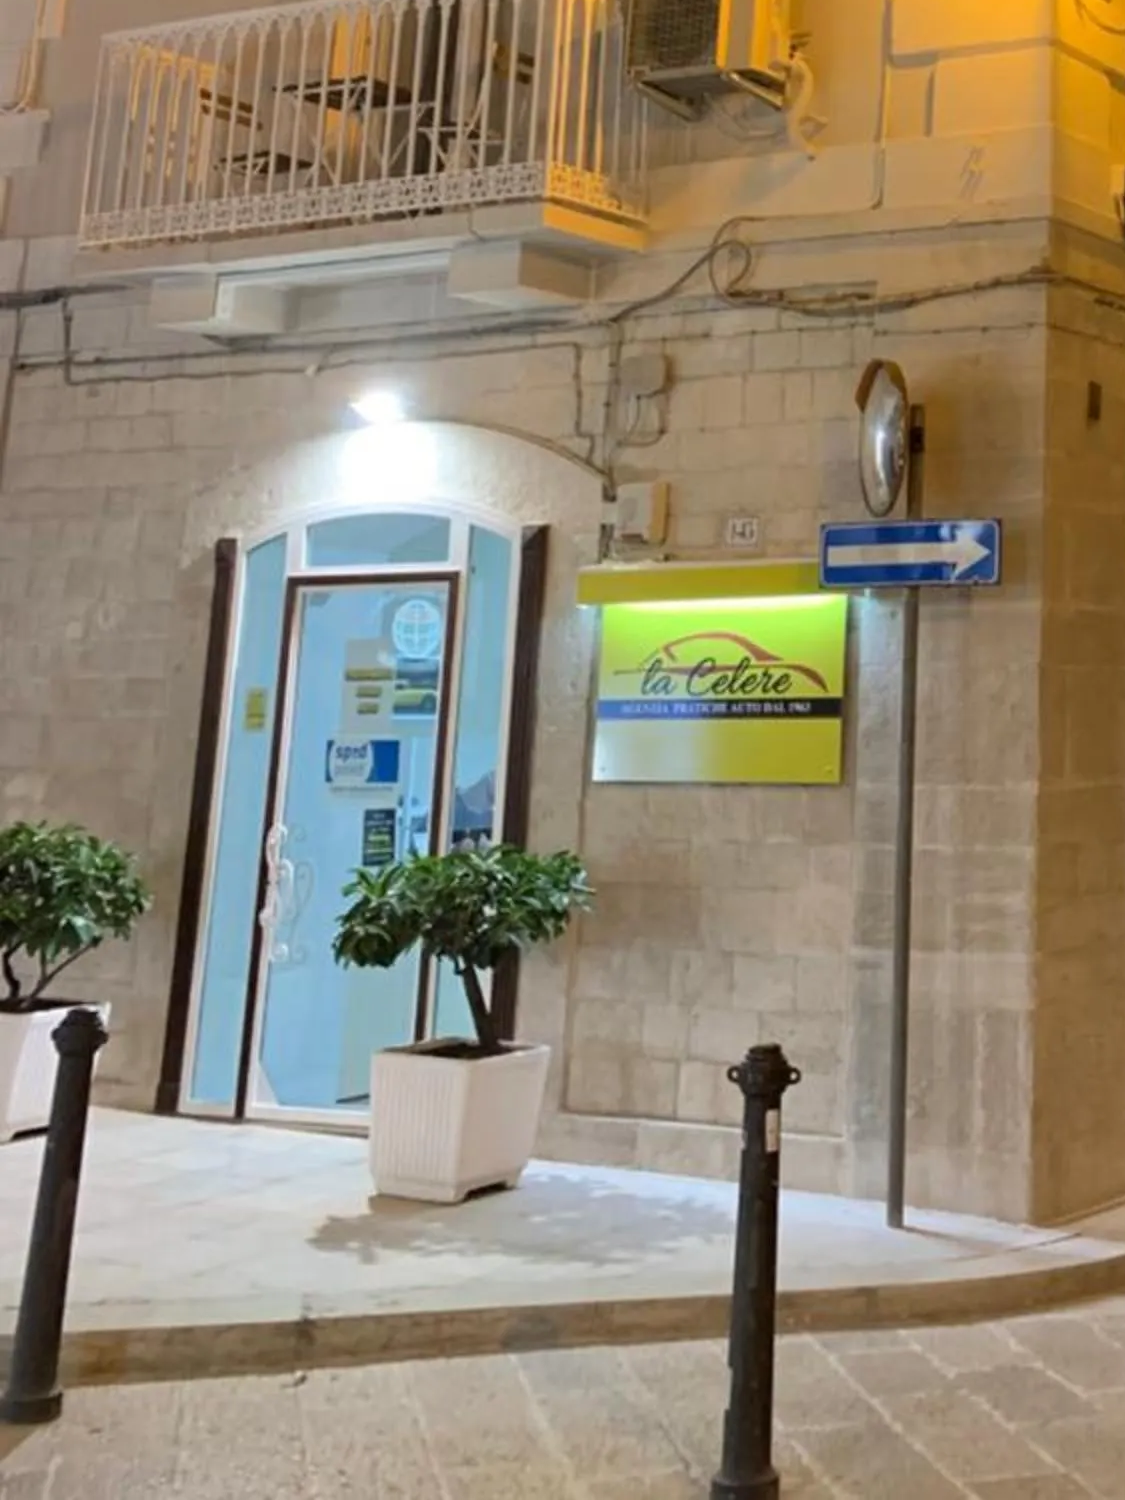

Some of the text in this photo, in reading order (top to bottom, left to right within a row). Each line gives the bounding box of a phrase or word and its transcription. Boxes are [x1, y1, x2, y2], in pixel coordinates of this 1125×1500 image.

[641, 656, 793, 697] la Celere
[672, 702, 728, 714] PRATICHE
[730, 701, 761, 713] AUTO
